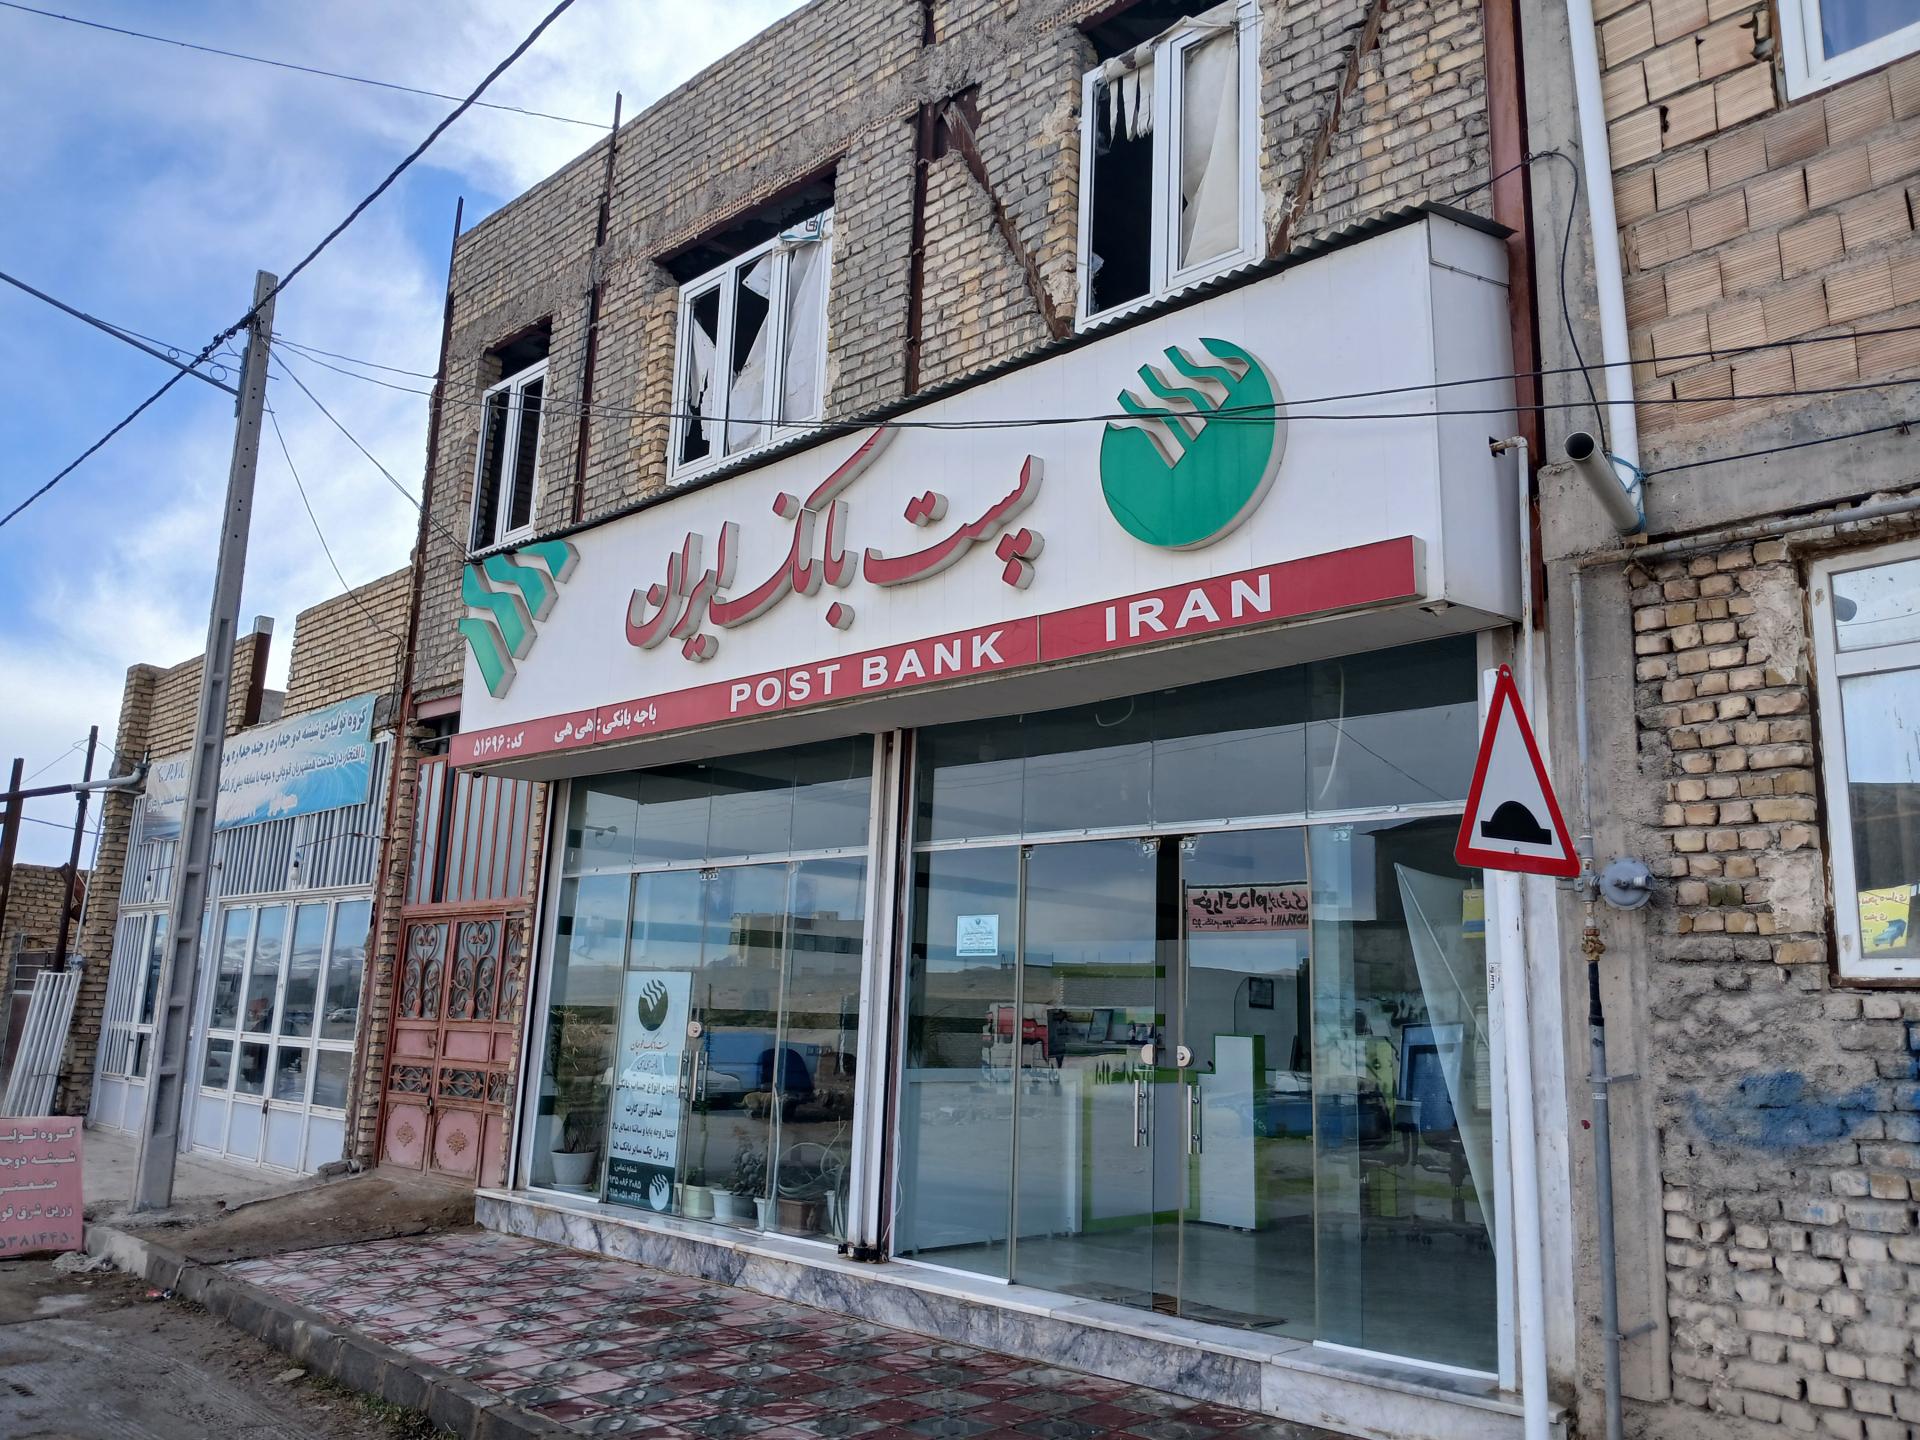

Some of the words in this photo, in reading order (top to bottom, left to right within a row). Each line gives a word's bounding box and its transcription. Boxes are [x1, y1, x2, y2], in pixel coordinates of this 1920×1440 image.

[709, 424, 898, 631] بانک
[863, 454, 1045, 589] پست
[625, 520, 740, 663] ایران
[729, 664, 840, 713] POST
[862, 630, 1005, 688] BANK
[1105, 573, 1273, 642] IRAN
[347, 704, 369, 733] گروه
[633, 701, 658, 728] باجه
[31, 1151, 77, 1166] شیشه
[40, 1126, 76, 1143] گروه
